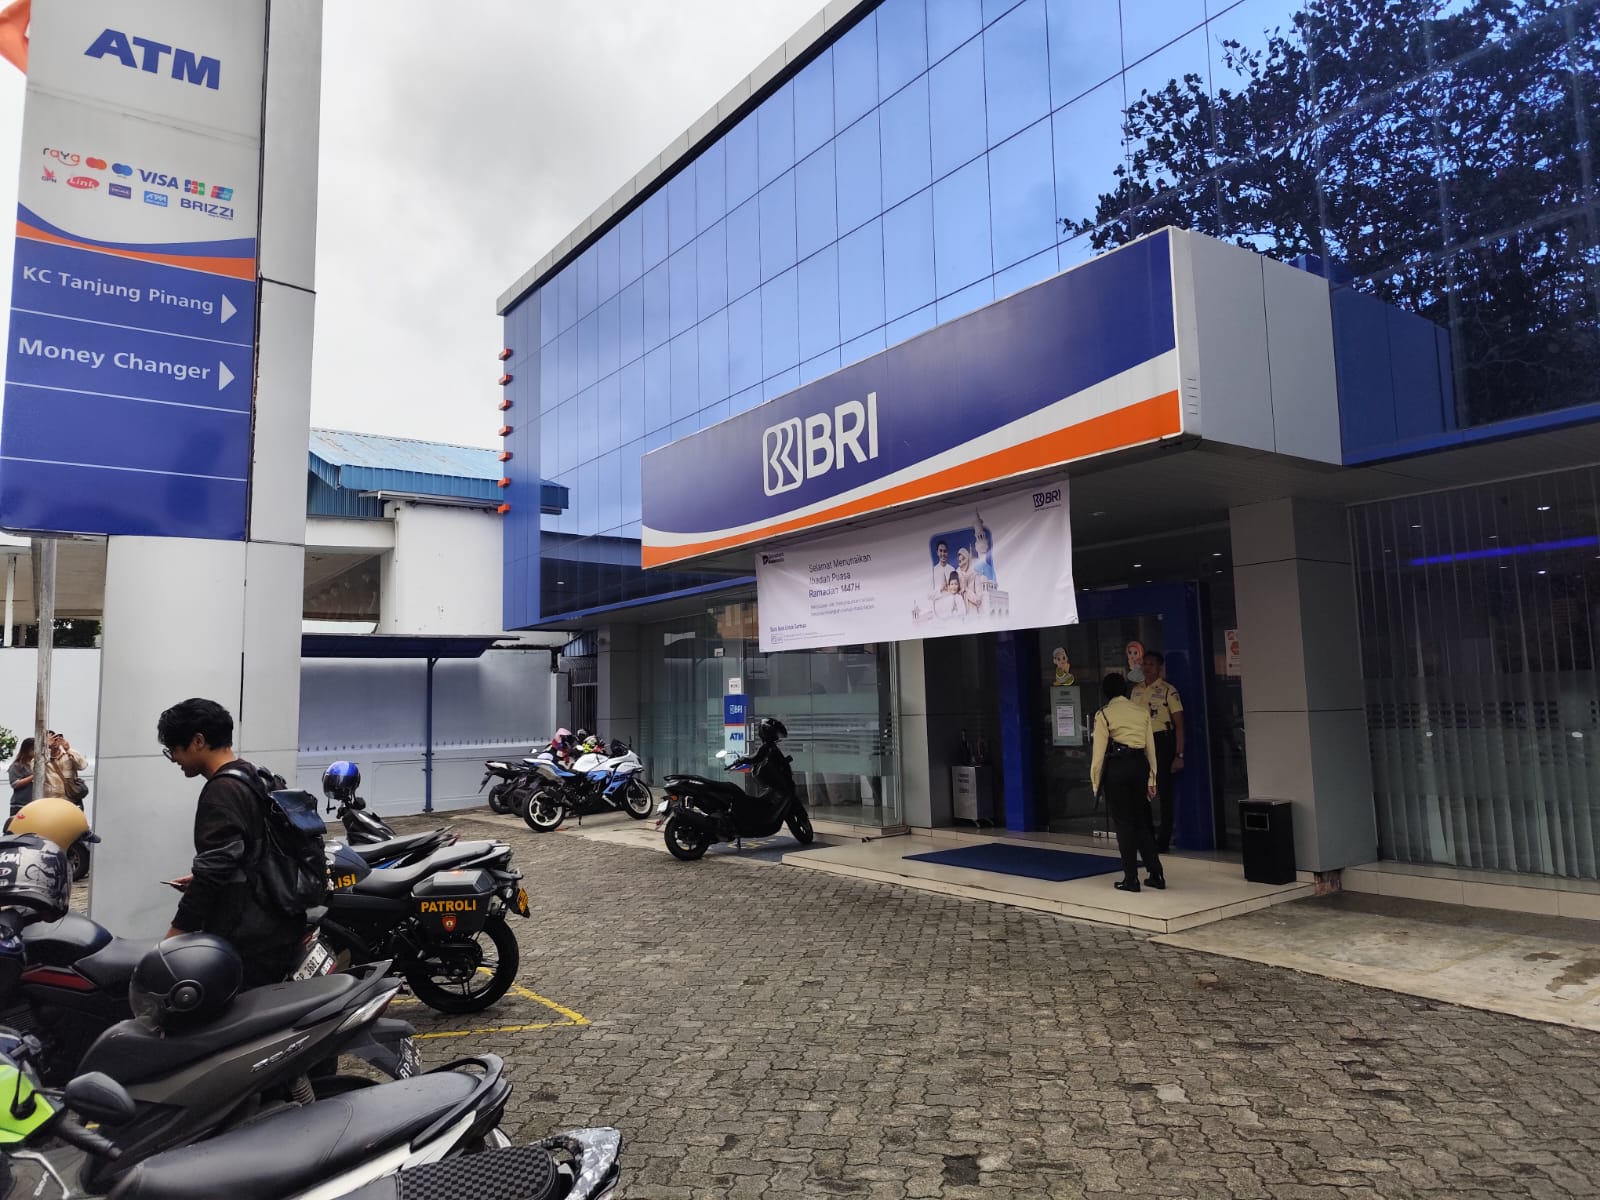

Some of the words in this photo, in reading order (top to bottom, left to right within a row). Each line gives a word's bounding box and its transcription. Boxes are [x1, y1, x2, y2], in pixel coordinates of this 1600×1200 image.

[84, 28, 221, 90] ATM
[137, 168, 179, 190] VISA
[180, 198, 234, 218] BRIZZI
[23, 265, 52, 284] KC
[58, 272, 142, 302] Tanjung
[149, 289, 214, 315] Pinang
[18, 337, 105, 369] Money
[113, 352, 211, 381] Changer
[805, 391, 879, 480] BRI
[1045, 489, 1061, 504] BRI
[808, 561, 832, 573] Selamat
[833, 553, 872, 569] Menunaikan
[832, 572, 851, 582] Puasa
[420, 899, 477, 912] PATROLI
